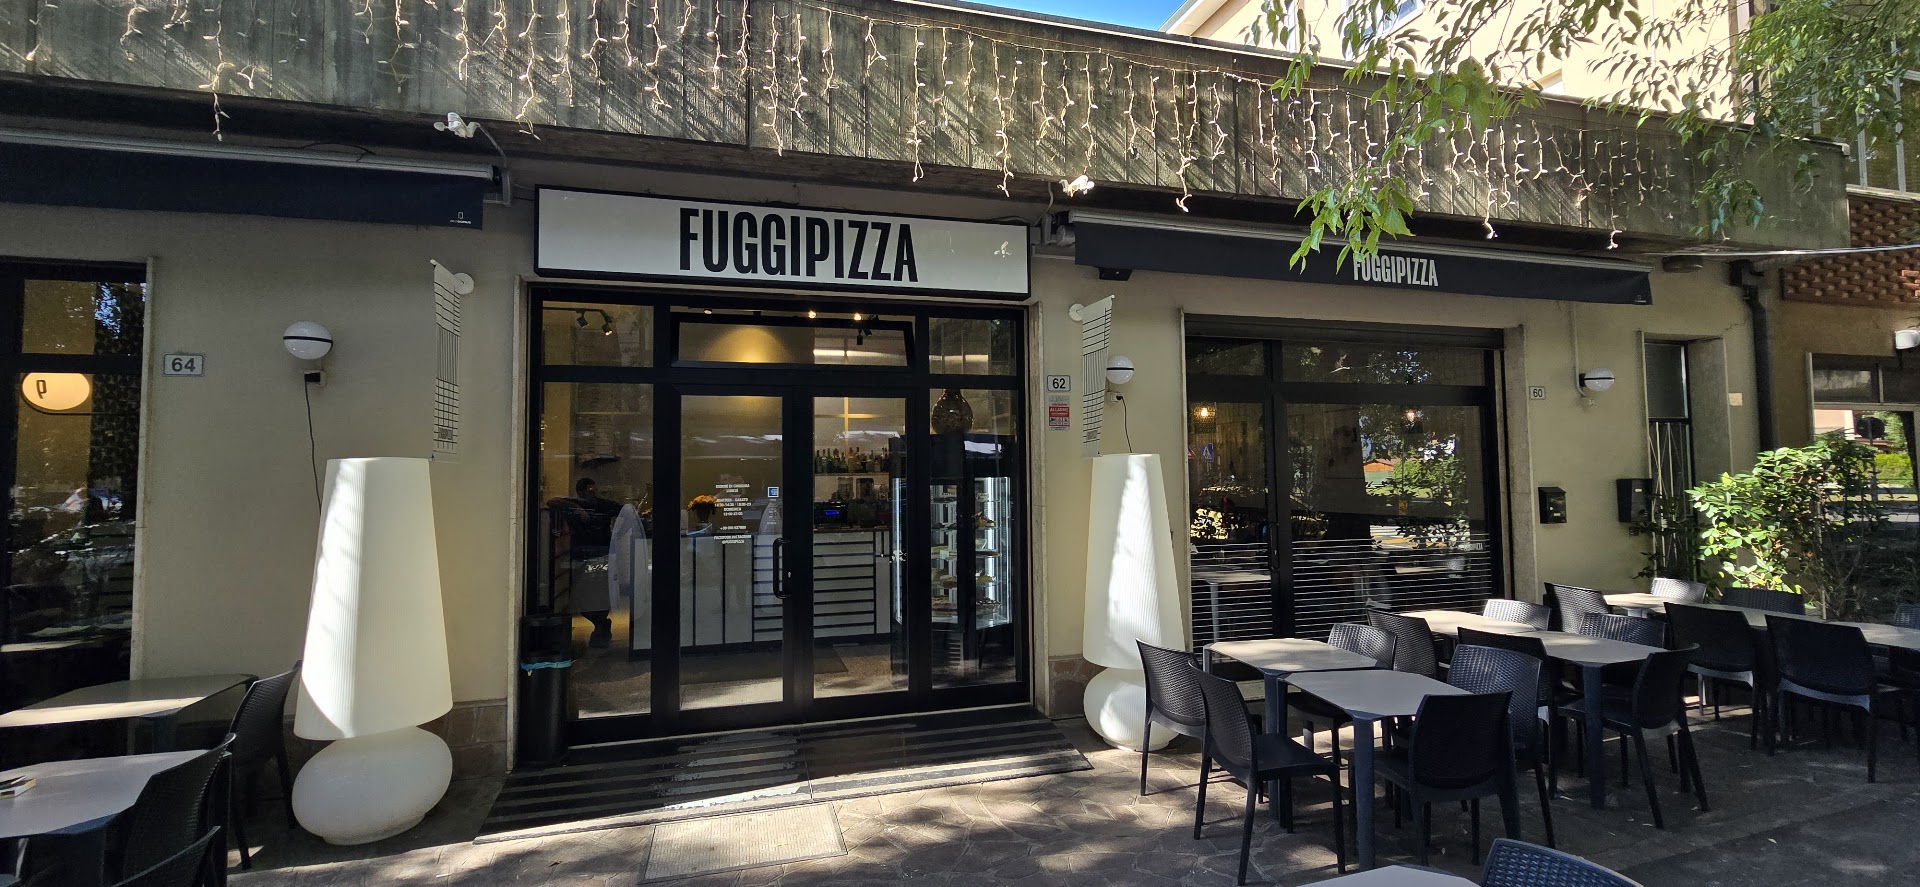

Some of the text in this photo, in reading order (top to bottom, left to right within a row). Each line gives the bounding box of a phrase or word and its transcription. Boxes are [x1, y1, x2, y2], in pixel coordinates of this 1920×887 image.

[679, 207, 919, 283] FUGGIPIZZA
[1353, 252, 1439, 287] FUGGIPIZZA
[171, 357, 196, 372] 64
[1052, 377, 1066, 389] 62
[1533, 388, 1543, 398] 60
